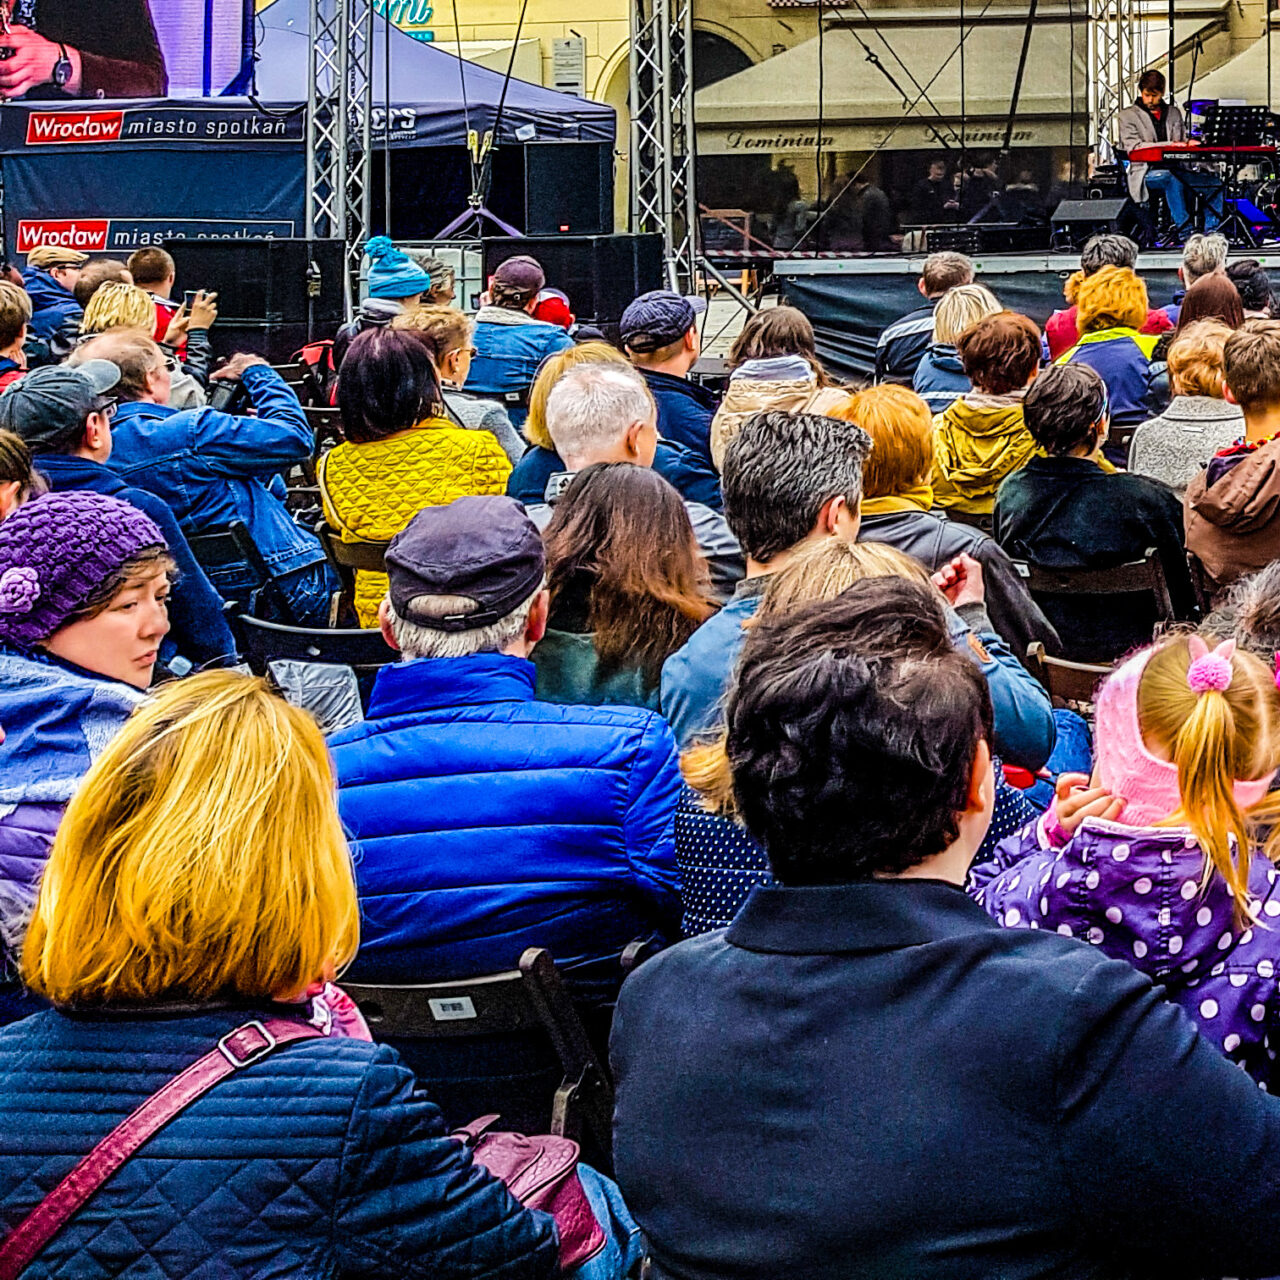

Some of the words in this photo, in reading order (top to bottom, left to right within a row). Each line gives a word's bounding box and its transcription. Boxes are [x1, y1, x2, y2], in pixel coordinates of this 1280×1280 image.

[33, 117, 119, 138] Wrocław
[128, 117, 198, 135] miasto
[205, 116, 286, 138] spotkań
[925, 126, 1035, 143] Dominim
[726, 129, 834, 150] Dominium
[22, 224, 104, 246] Wrocław
